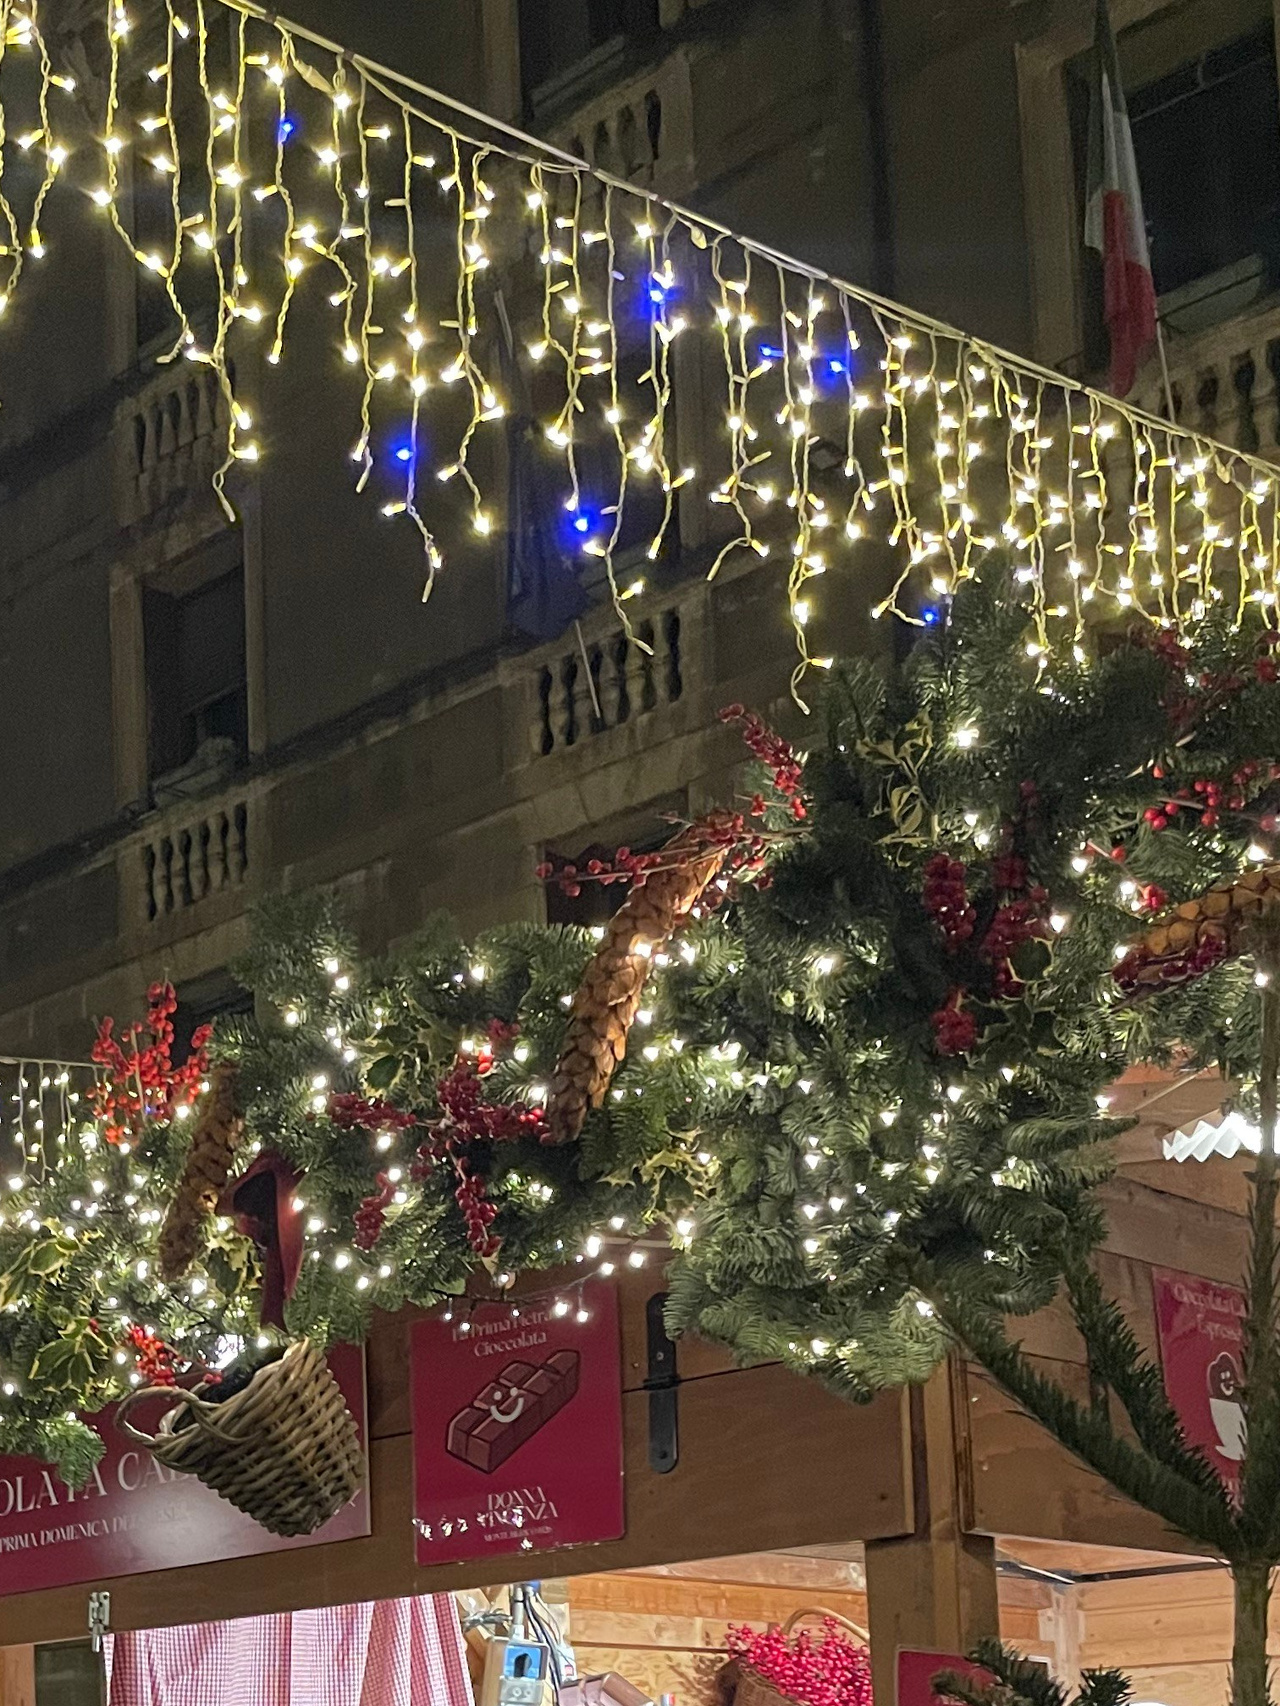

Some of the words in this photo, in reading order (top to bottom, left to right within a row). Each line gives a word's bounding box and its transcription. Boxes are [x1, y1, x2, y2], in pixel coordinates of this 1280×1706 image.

[474, 1332, 547, 1357] Cioccolata
[488, 1486, 546, 1511] DONNA
[479, 1501, 558, 1528] INCNZA
[41, 1518, 110, 1545] DOMENICA
